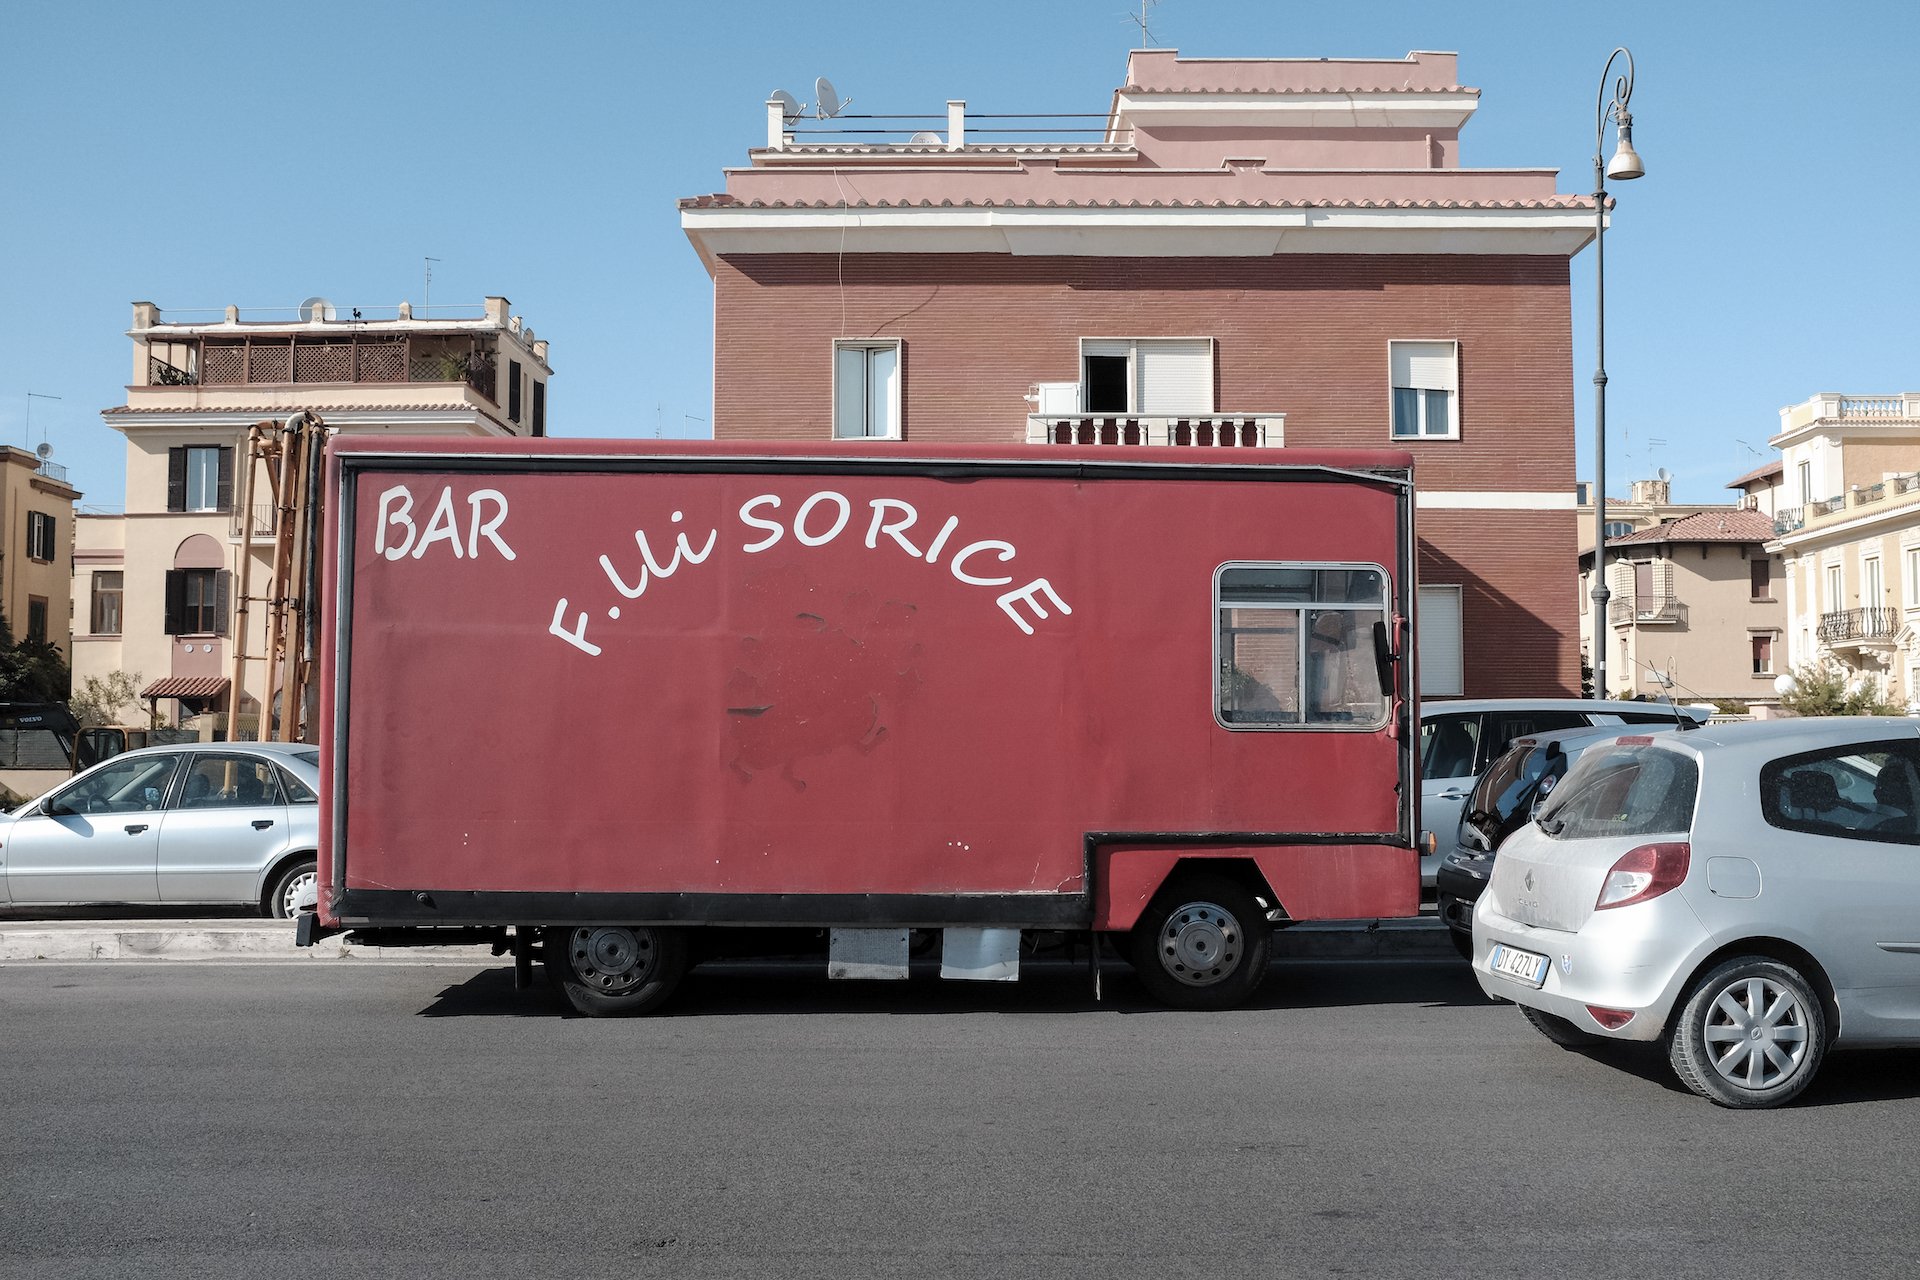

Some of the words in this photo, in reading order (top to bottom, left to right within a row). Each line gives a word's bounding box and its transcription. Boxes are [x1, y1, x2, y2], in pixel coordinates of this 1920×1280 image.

[374, 484, 517, 562] BAR
[738, 490, 1073, 636] SORICE
[1518, 898, 1539, 908] CLIO
[1497, 948, 1512, 970] DY
[1510, 952, 1542, 979] 427LY
